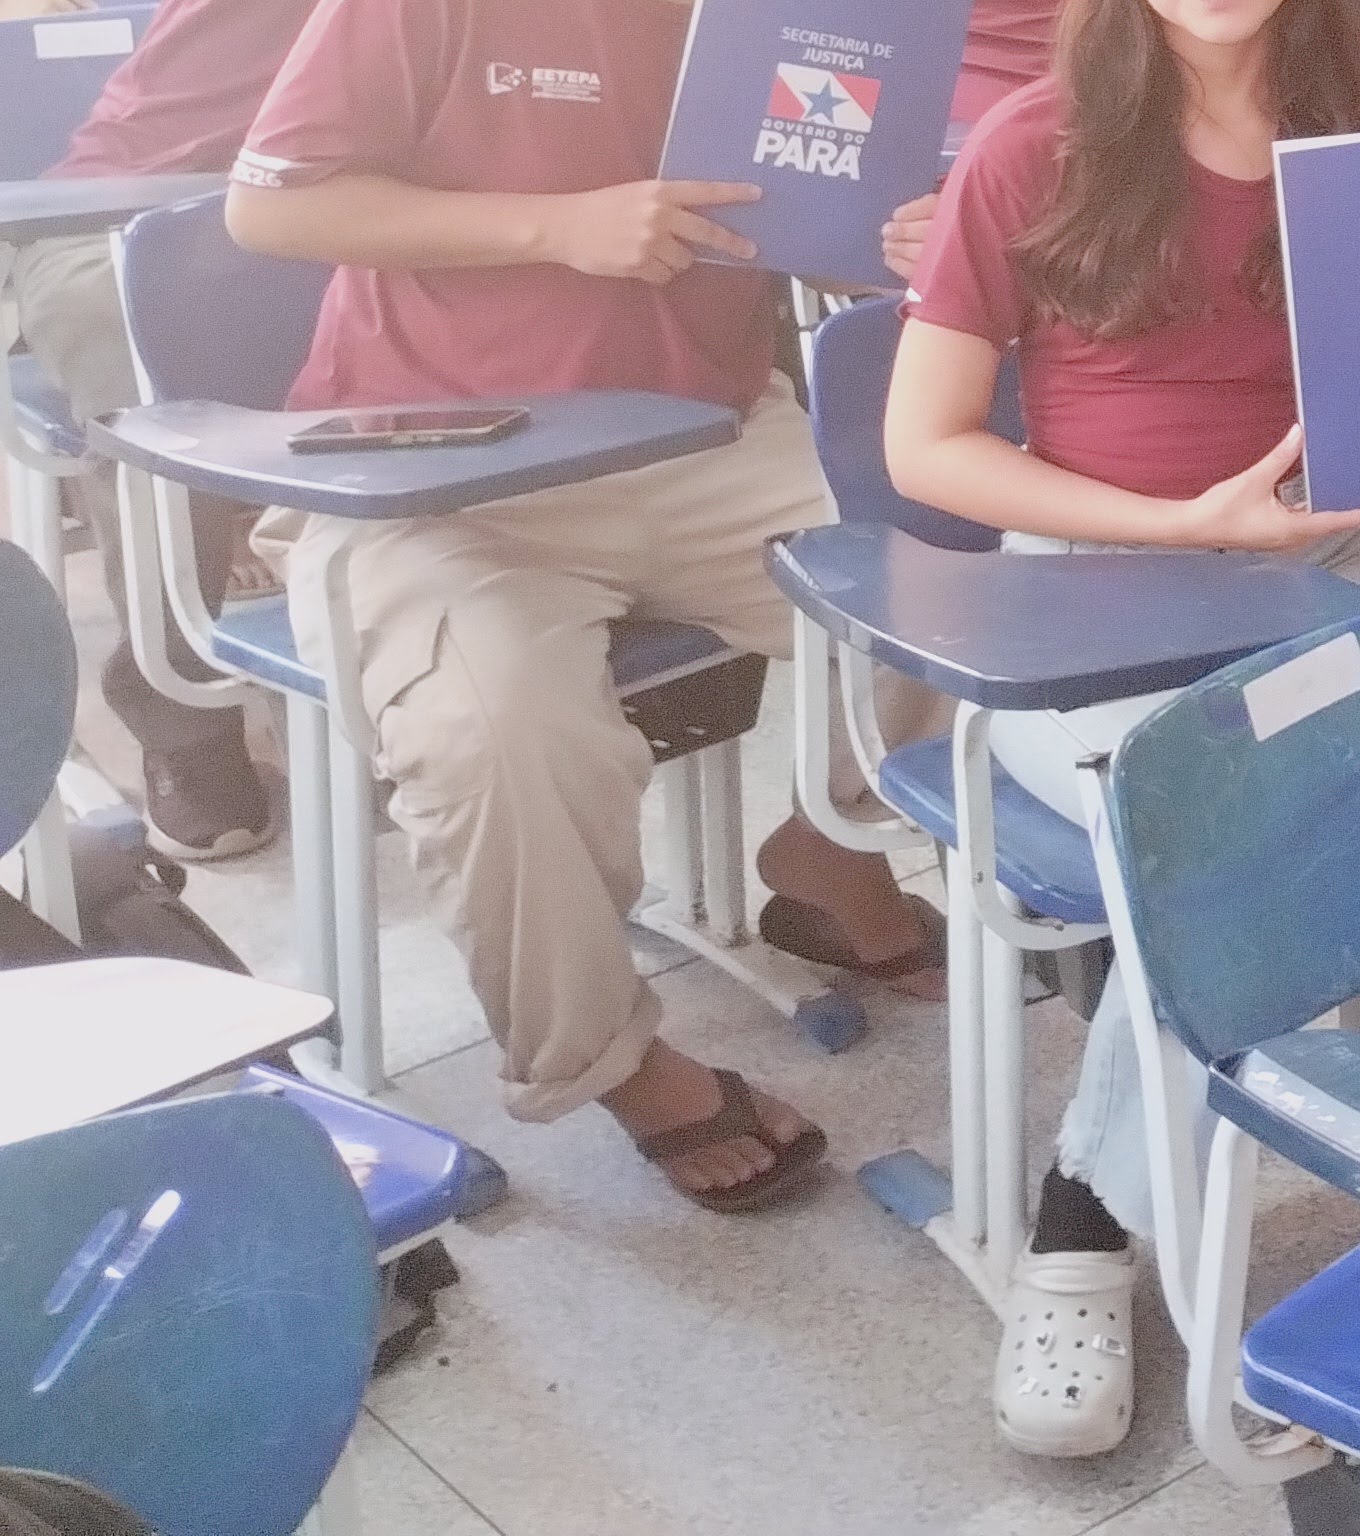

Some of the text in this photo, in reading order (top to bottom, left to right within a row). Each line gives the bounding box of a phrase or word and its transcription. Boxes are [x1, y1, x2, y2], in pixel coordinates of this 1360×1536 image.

[781, 26, 896, 59] SECRETARIA DE
[802, 48, 865, 71] JUSTIÇA
[532, 68, 600, 85] EETEPA
[761, 117, 866, 145] GOVERNO DO
